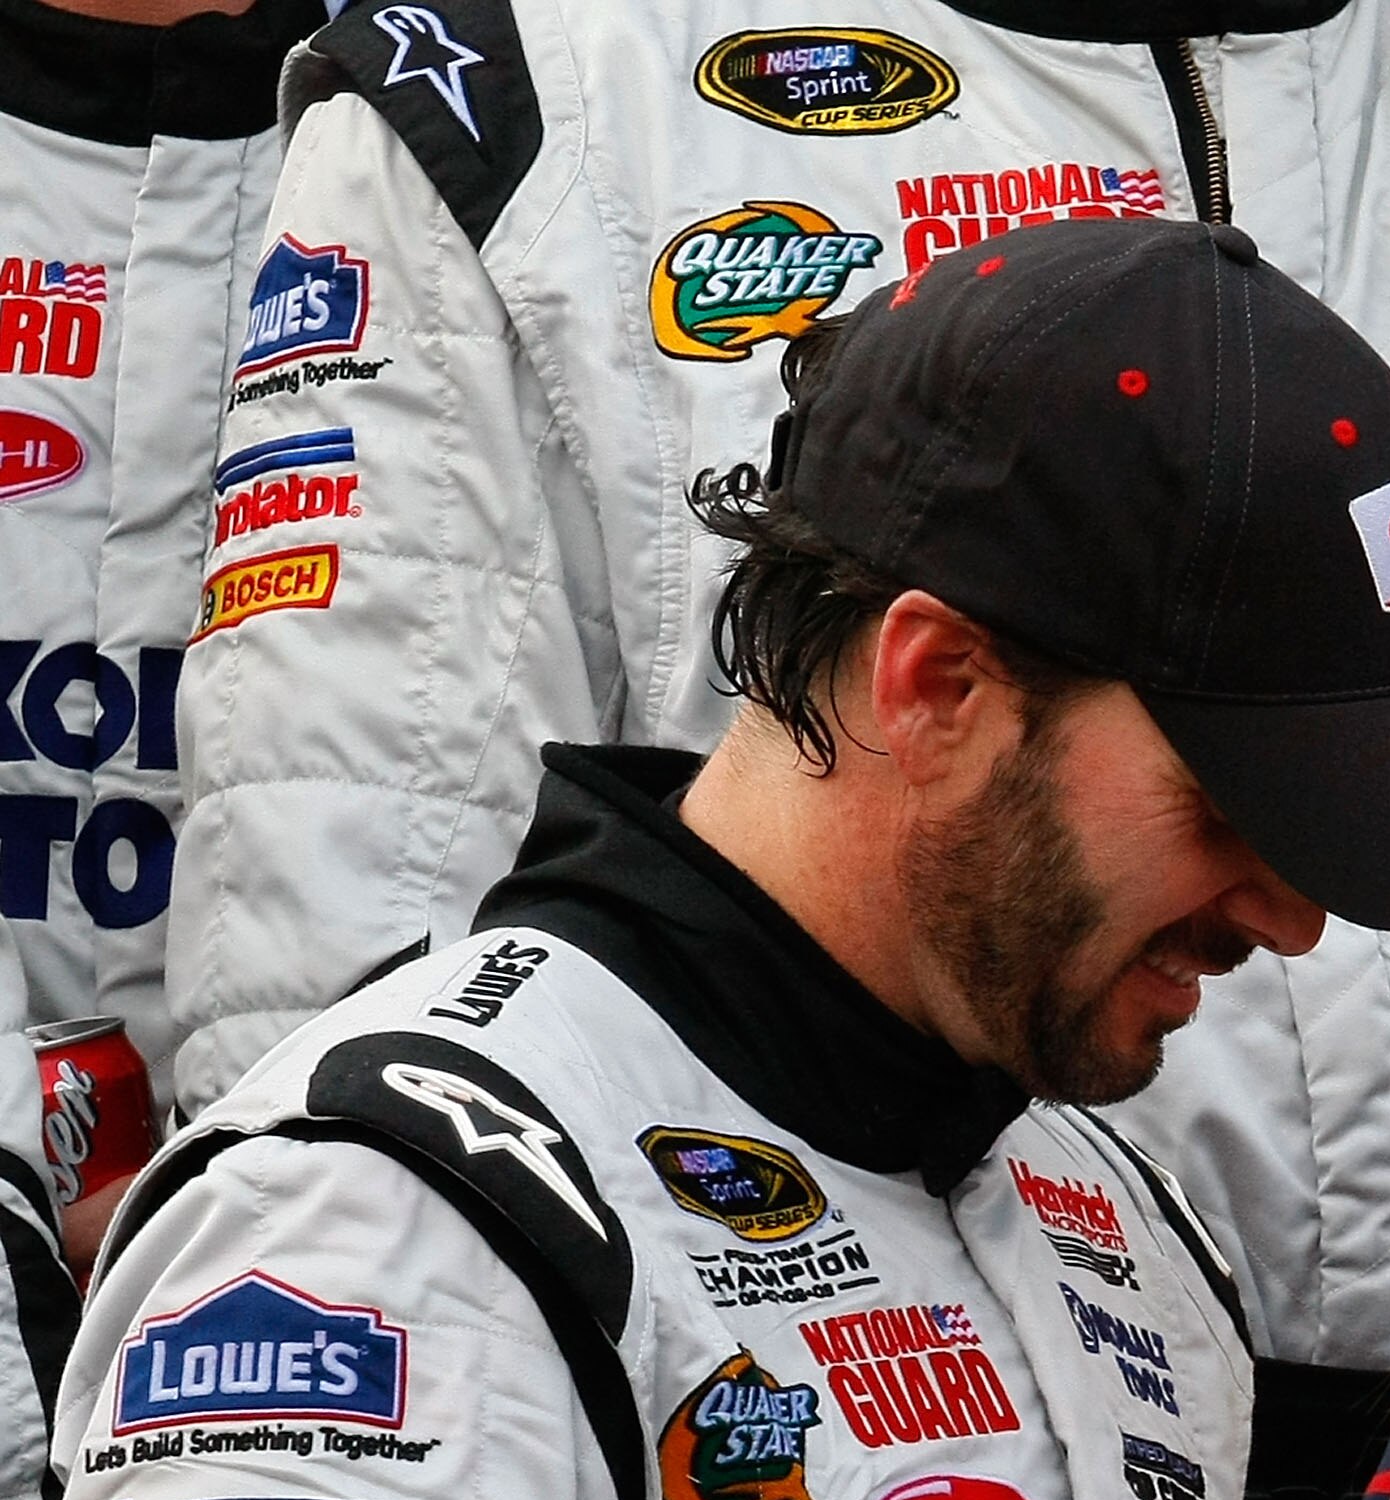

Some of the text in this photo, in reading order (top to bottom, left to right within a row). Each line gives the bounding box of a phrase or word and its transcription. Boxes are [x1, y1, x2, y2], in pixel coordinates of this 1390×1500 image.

[765, 45, 854, 75] NASCAR
[786, 71, 872, 105] Sprint
[801, 99, 930, 126] CUP SERIES
[896, 163, 1122, 219] NATIONAL
[671, 233, 877, 276] QUAKER
[695, 265, 845, 306] STATE
[301, 357, 384, 388] Together
[221, 562, 320, 614] BOSCH
[699, 1175, 761, 1207] Sprint
[756, 1204, 815, 1231] SERIES
[800, 1306, 950, 1367] NATIONAL
[148, 1330, 362, 1403] LOWE'S
[828, 1349, 1021, 1449] GUARD
[85, 1424, 434, 1473] Let's Build Something Together
